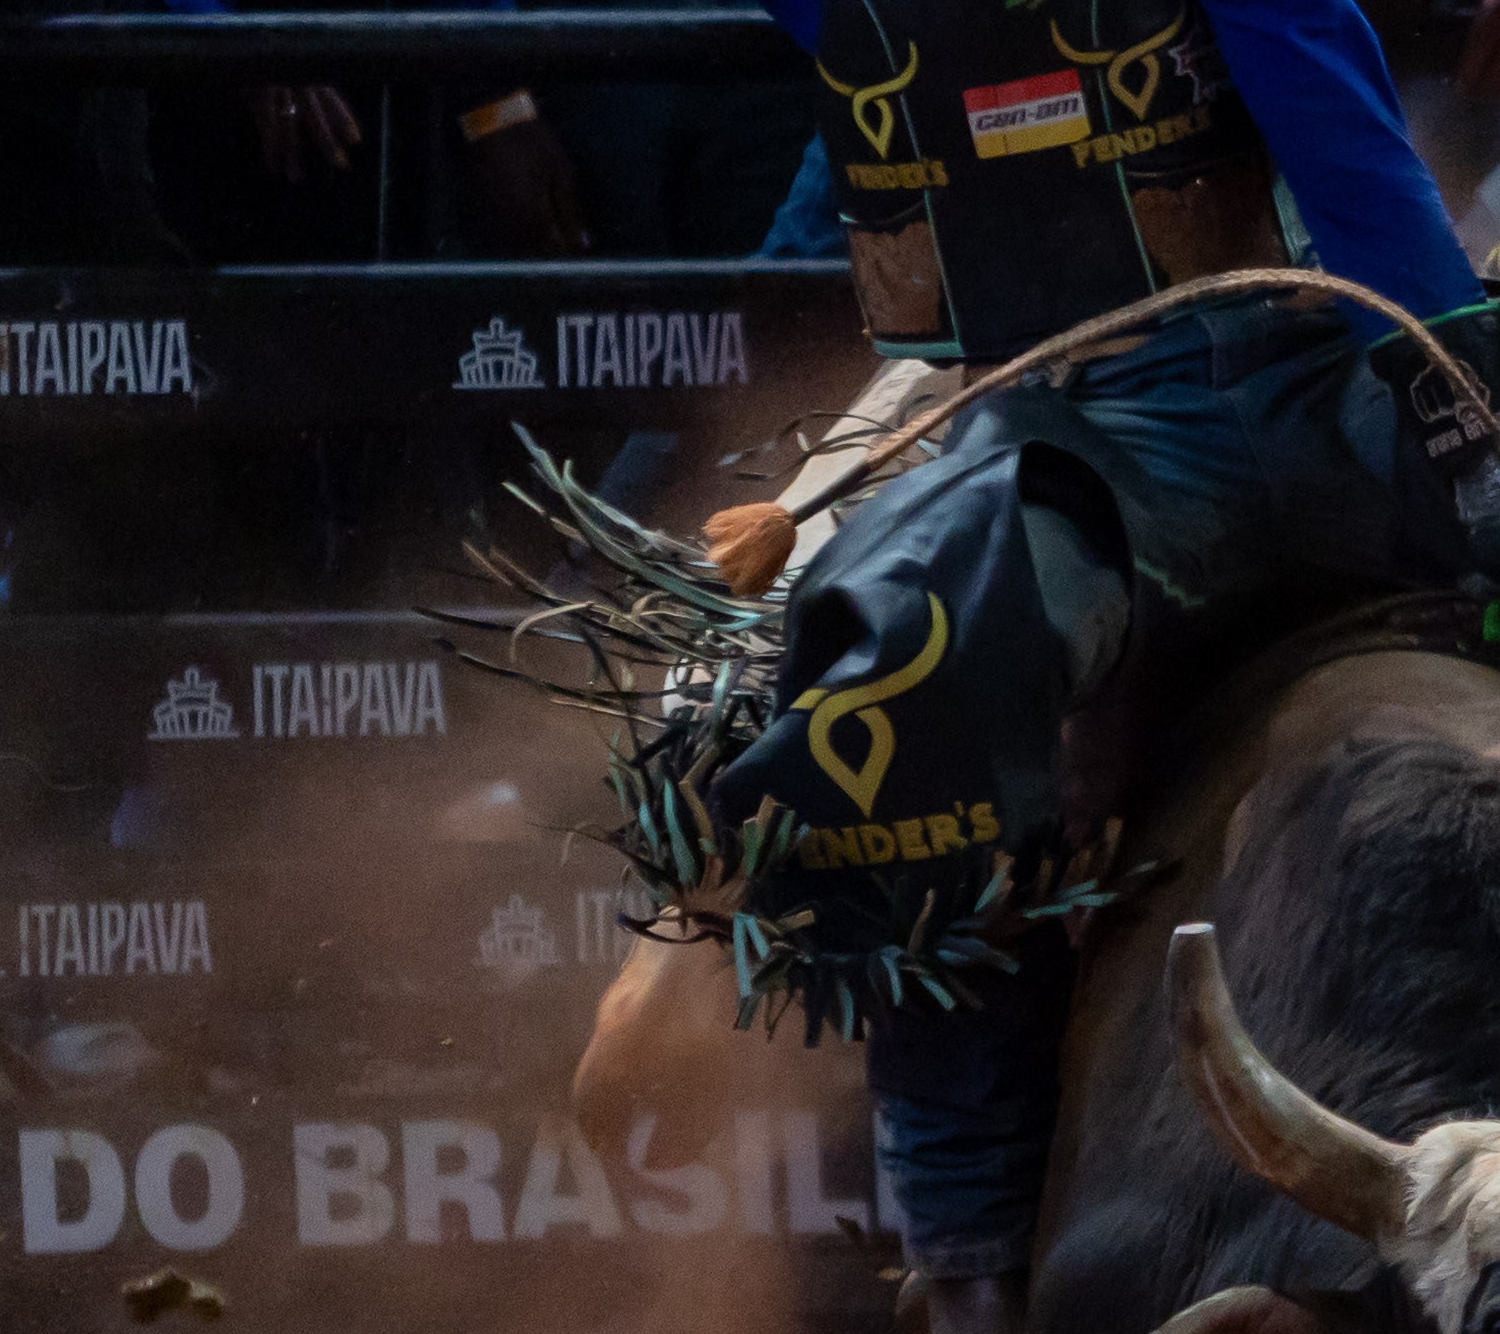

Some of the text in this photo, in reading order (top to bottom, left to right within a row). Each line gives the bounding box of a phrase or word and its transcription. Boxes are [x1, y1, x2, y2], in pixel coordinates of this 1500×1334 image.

[0, 321, 192, 396] ITAIPAVA
[556, 313, 748, 387] ITAIPAVA
[252, 663, 446, 737] ITAIPAVA
[799, 801, 998, 871] ENDER'S
[18, 901, 212, 976] ITAIPAVA
[19, 1123, 244, 1255] DO
[292, 1112, 902, 1247] BRASIL
